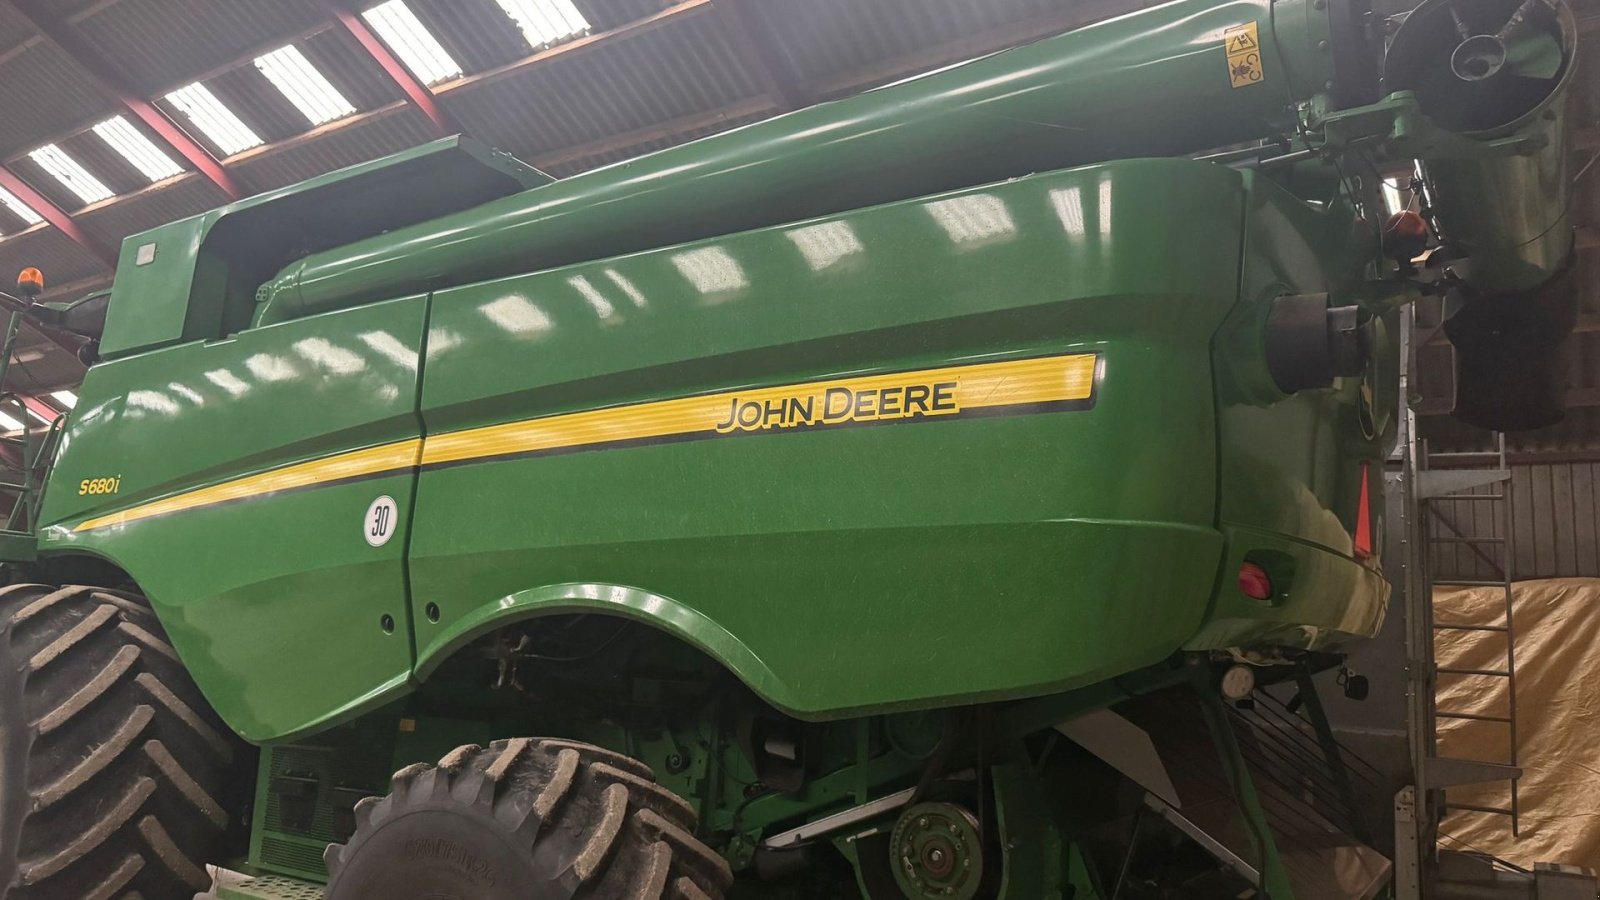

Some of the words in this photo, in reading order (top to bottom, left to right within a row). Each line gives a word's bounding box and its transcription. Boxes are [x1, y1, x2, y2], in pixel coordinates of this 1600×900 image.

[715, 396, 815, 431] JOHN
[822, 381, 959, 422] DEERE
[78, 473, 122, 496] S680i
[371, 505, 390, 537] 30
